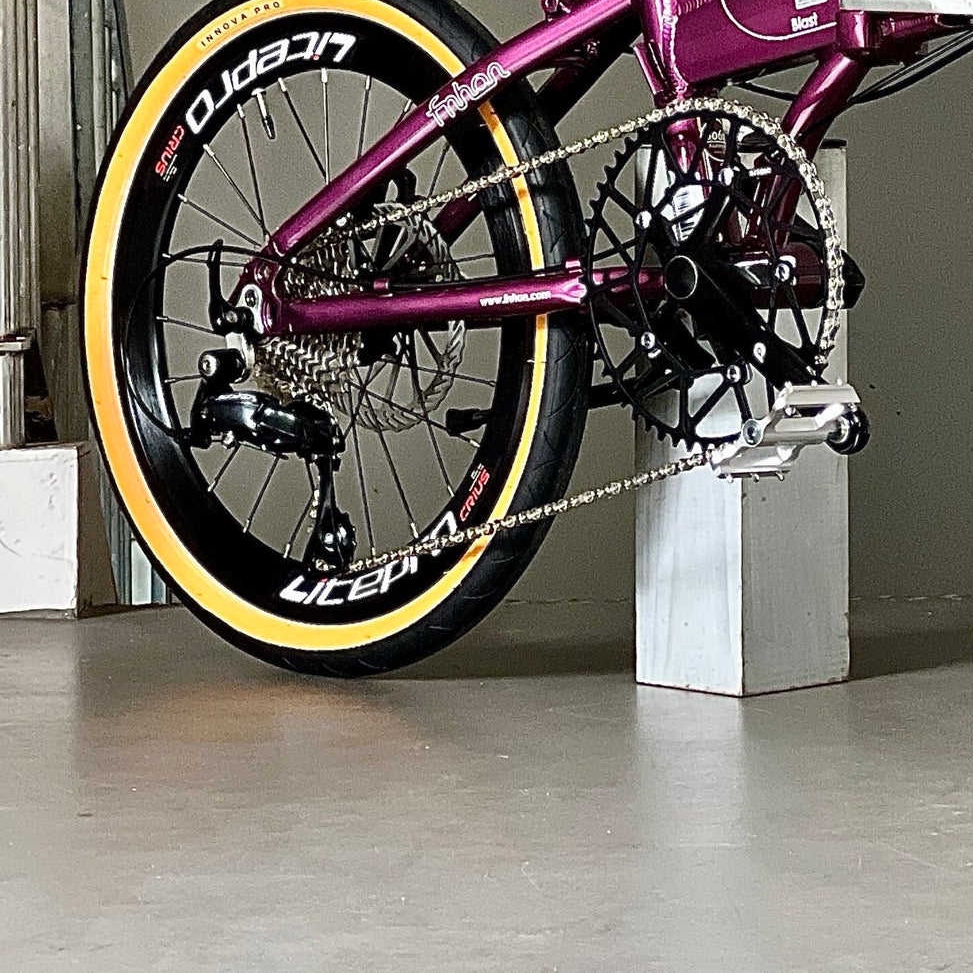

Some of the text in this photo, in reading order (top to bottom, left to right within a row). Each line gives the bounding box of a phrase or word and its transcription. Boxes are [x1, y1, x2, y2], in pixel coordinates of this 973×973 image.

[201, 1, 280, 47] INNOVA PRO
[791, 12, 818, 32] Blast
[185, 31, 357, 134] Litepro
[425, 61, 511, 127] fnhon
[155, 125, 185, 175] CRIUS
[460, 469, 490, 522] CRIUS
